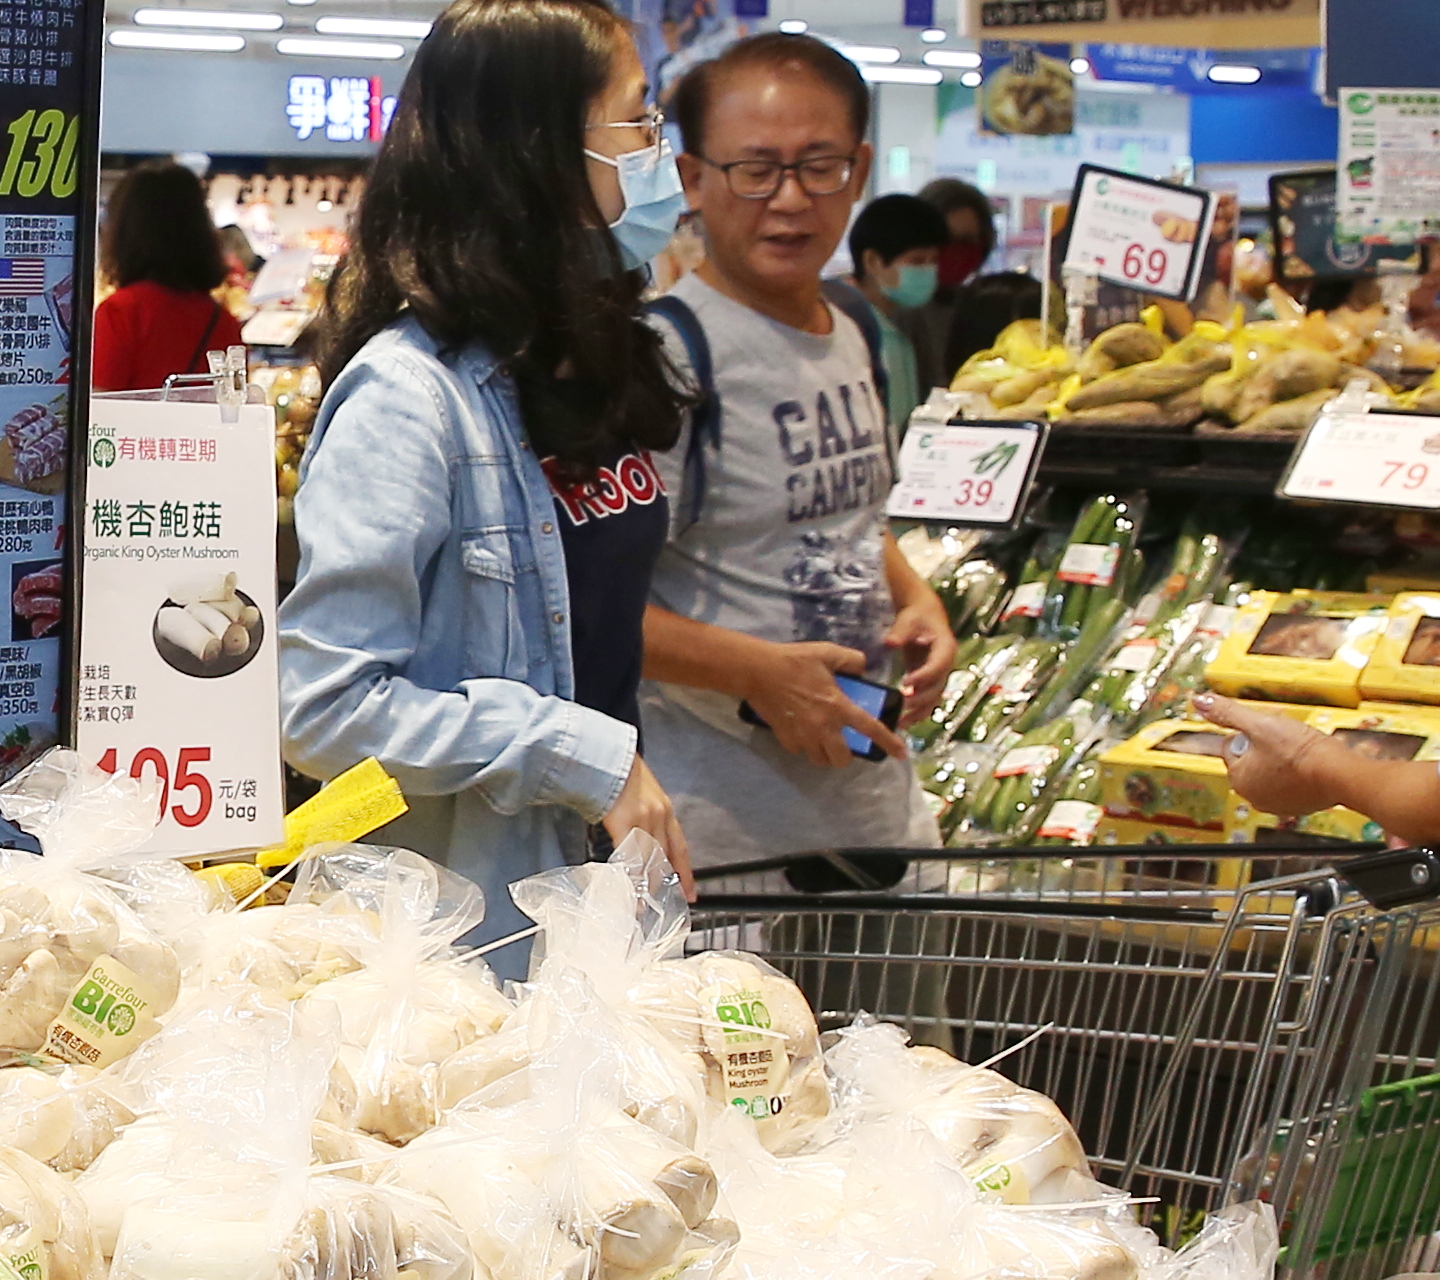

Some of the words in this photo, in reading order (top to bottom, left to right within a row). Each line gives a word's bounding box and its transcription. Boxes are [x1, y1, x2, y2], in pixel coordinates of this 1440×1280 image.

[1121, 242, 1168, 286] 69
[117, 435, 217, 463] 有機轉型期
[1381, 459, 1430, 492] 79
[953, 478, 994, 508] 39
[83, 500, 223, 540] 機杏鮑菇
[121, 544, 145, 561] King
[146, 544, 181, 561] Oyster
[183, 544, 239, 559] Mushroom
[77, 663, 111, 682] 栽培
[218, 777, 258, 800] 元/袋
[224, 801, 257, 822] bag
[91, 965, 149, 1013] Carrefour
[71, 979, 138, 1038] BIO
[715, 1000, 772, 1034] BIO
